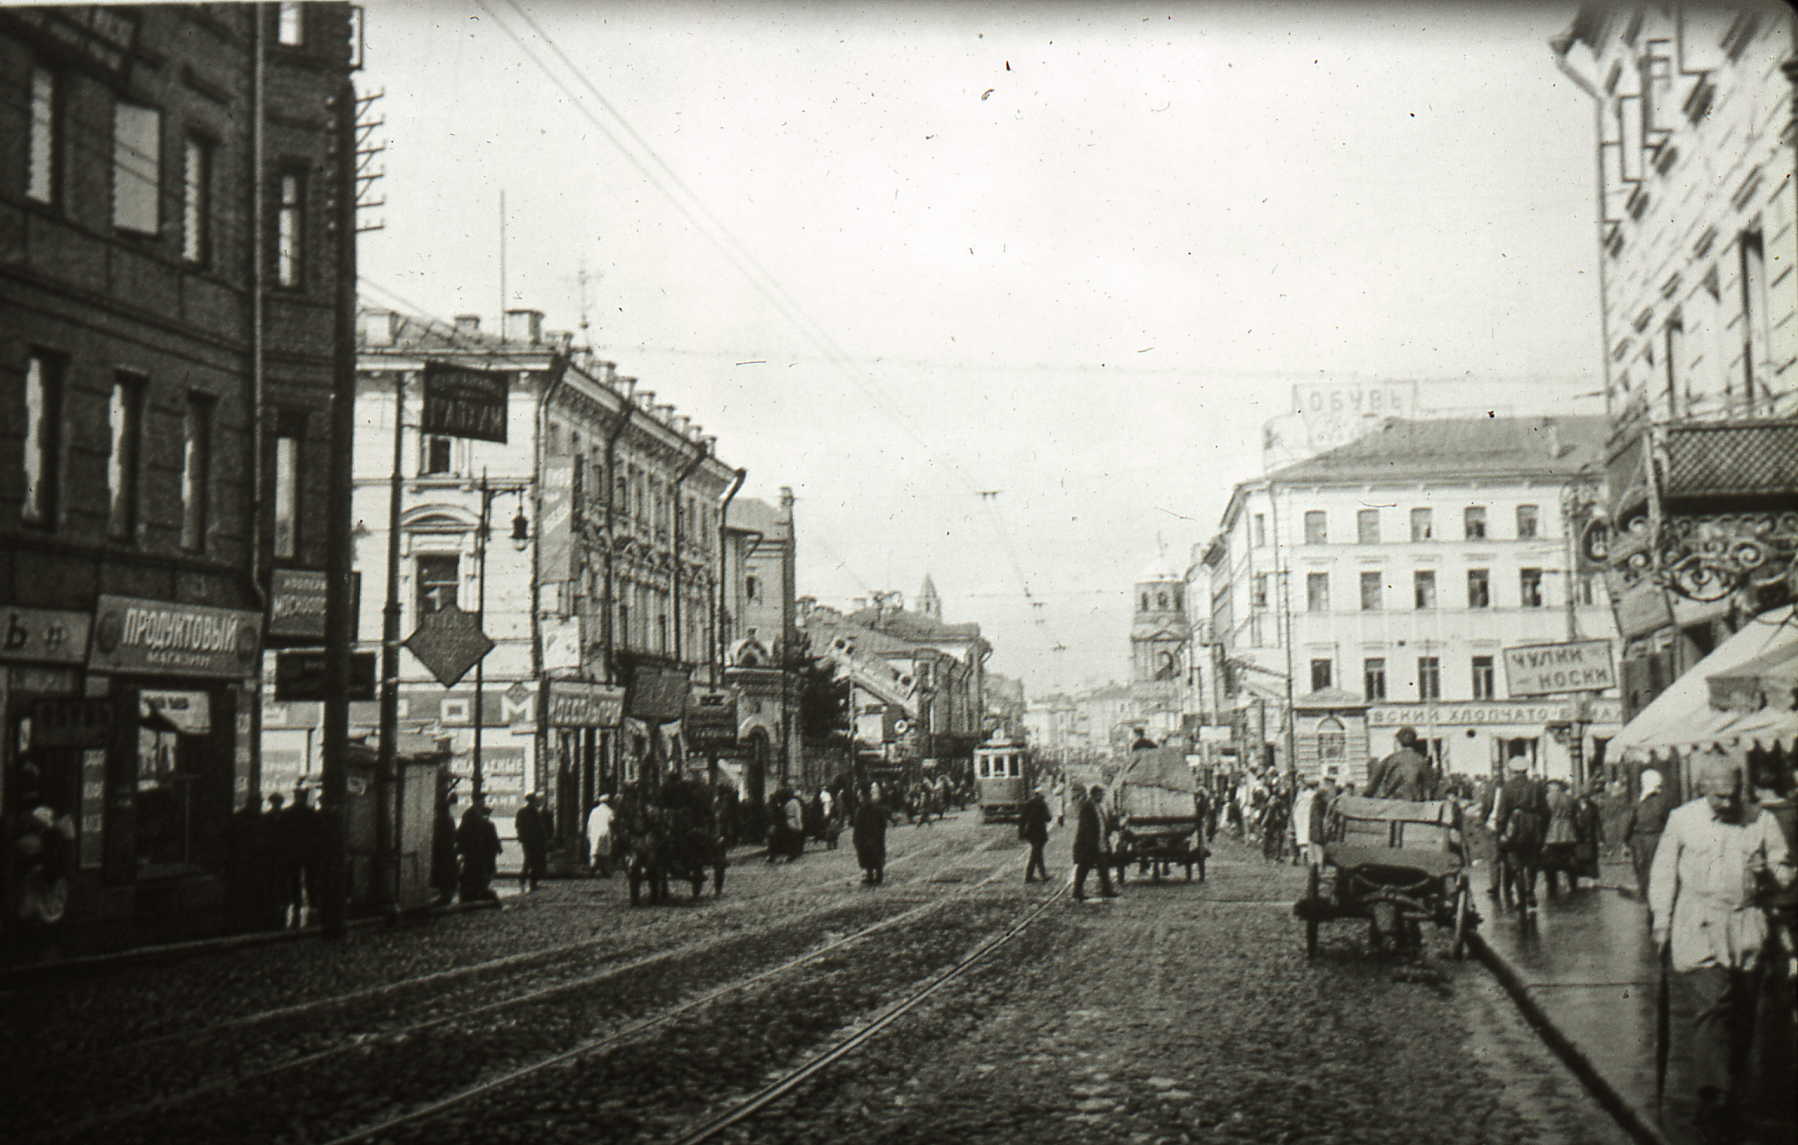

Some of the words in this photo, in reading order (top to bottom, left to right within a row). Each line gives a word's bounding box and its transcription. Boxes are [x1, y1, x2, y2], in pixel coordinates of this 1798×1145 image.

[1309, 389, 1402, 412] ОБУВЬ
[122, 607, 239, 653] ПРОДУКТОВЫЙ
[1510, 648, 1583, 669] ЧУЛКИ
[1538, 667, 1608, 690] НОСКИ
